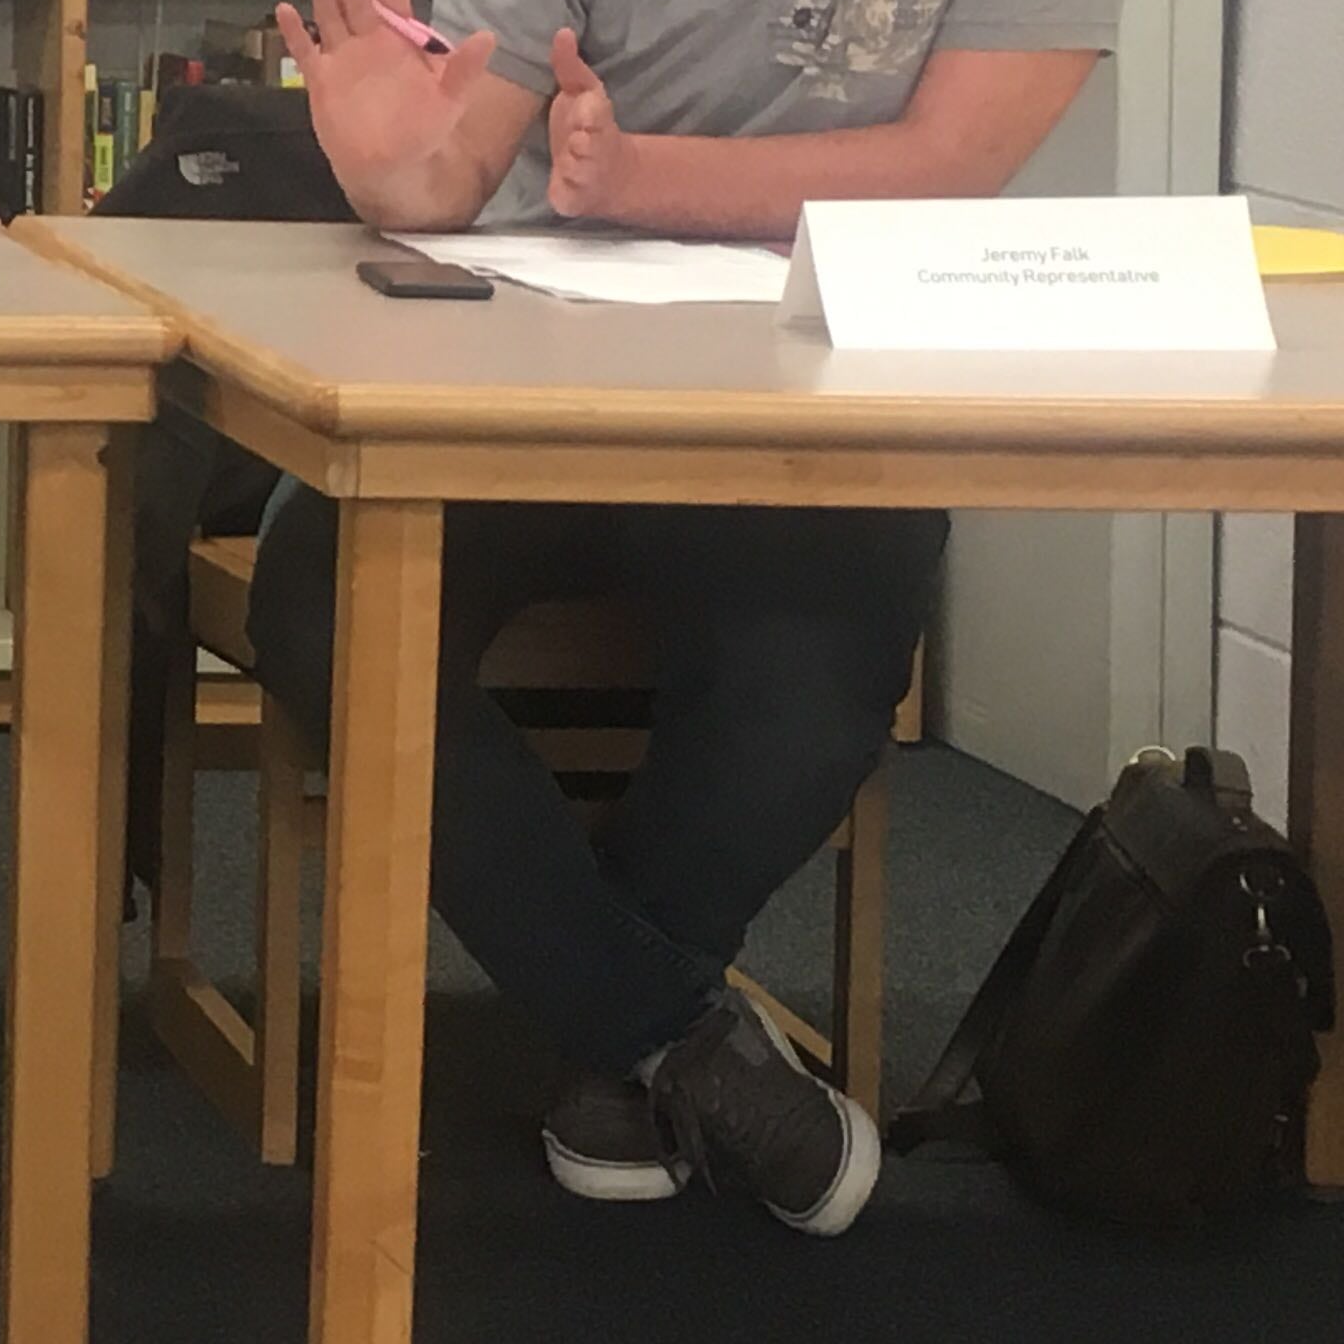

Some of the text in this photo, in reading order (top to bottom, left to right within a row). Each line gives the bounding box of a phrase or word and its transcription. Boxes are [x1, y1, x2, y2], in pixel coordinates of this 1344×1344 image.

[981, 247, 1090, 265] Jeremy Falk
[917, 268, 1160, 286] Community Representative
